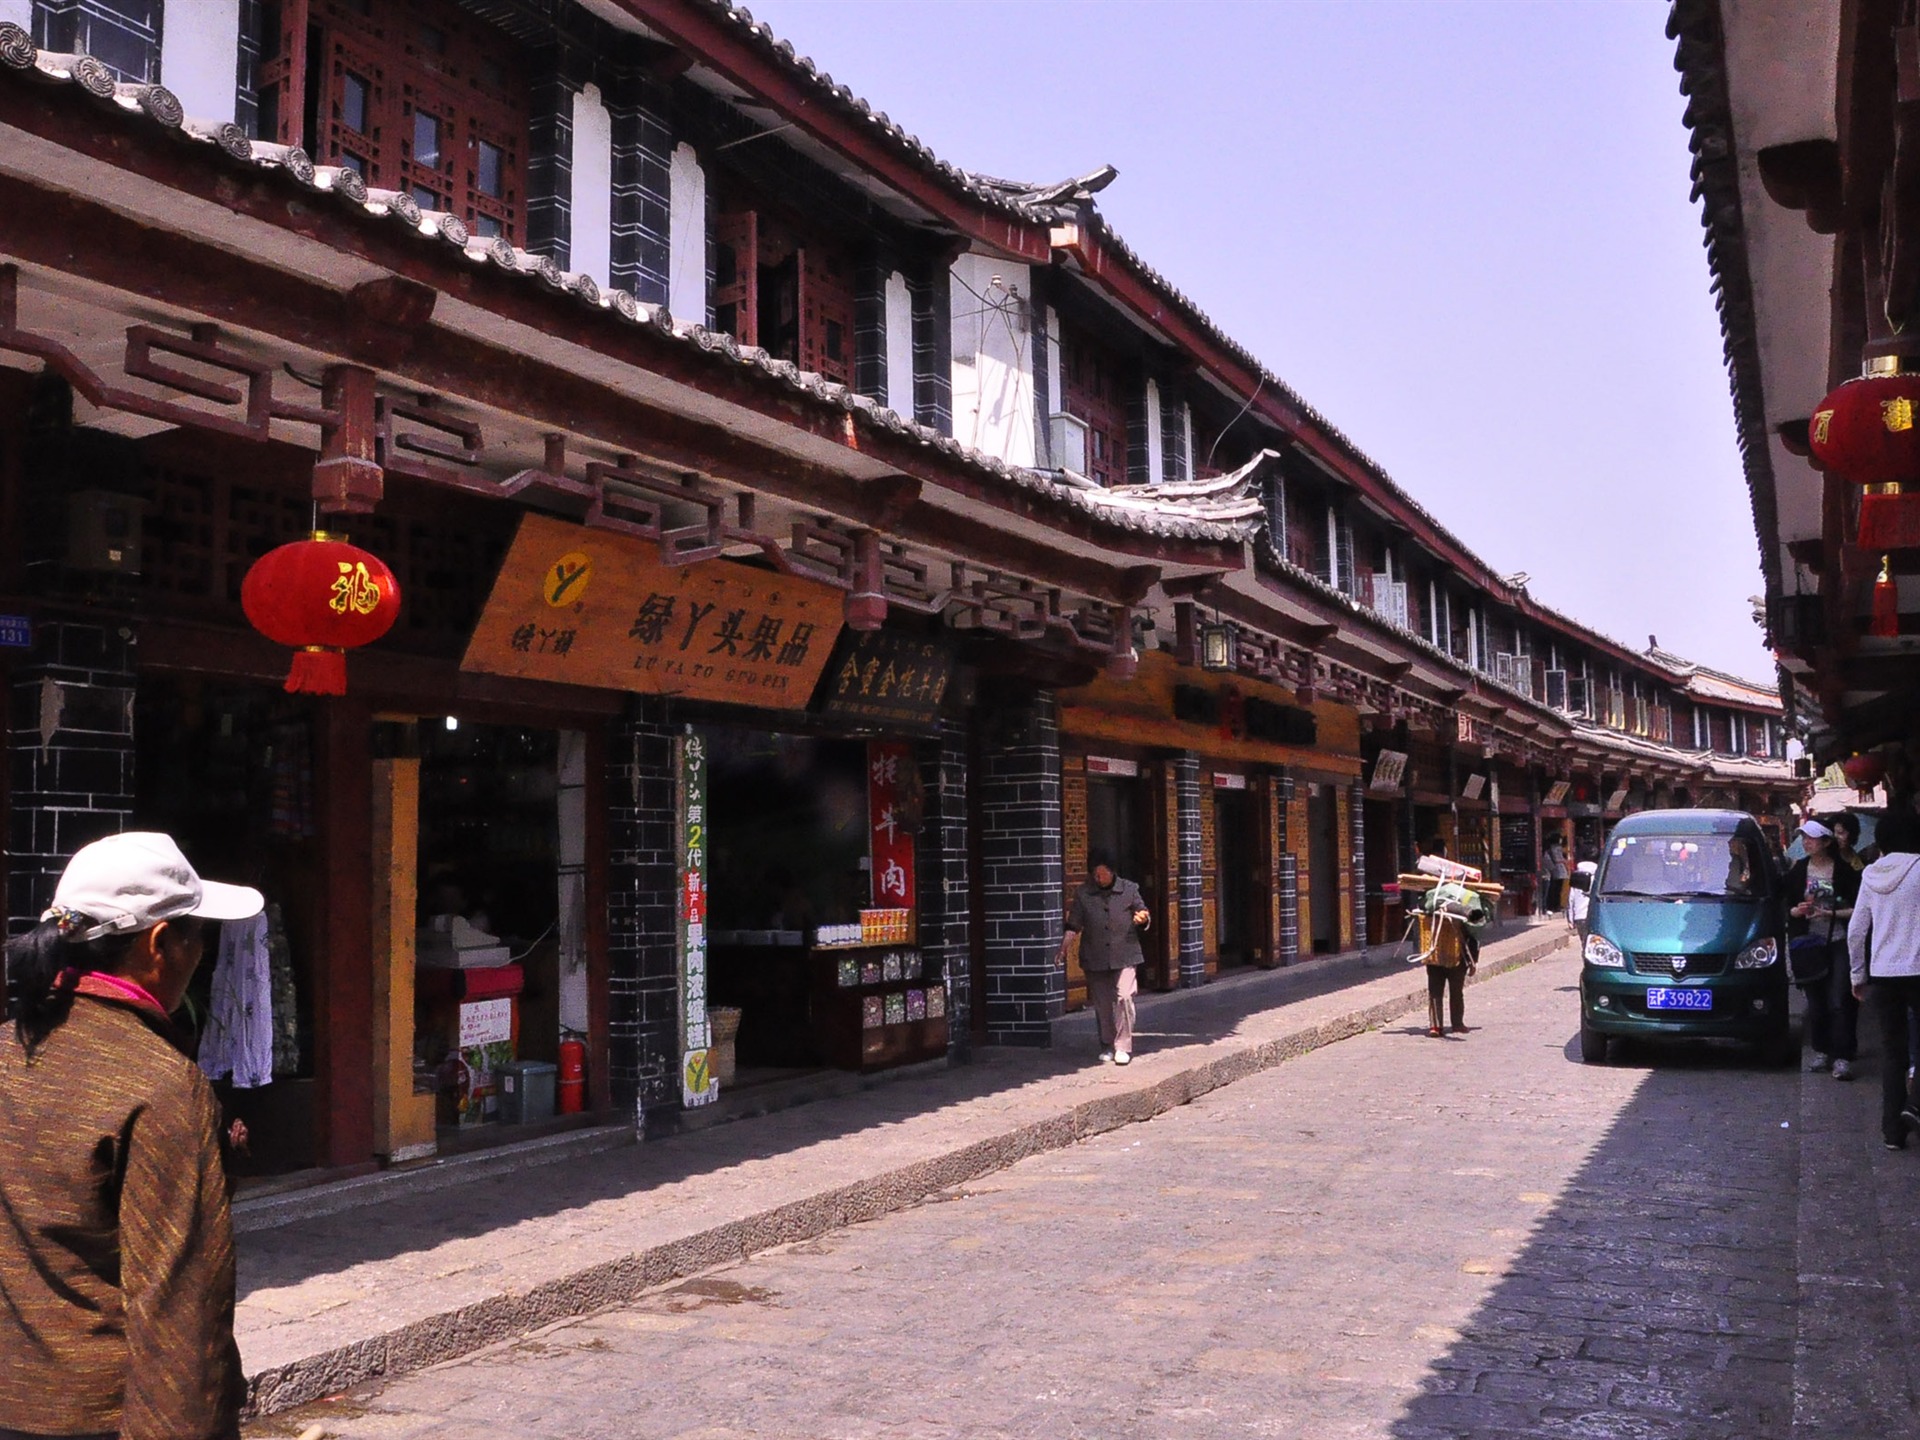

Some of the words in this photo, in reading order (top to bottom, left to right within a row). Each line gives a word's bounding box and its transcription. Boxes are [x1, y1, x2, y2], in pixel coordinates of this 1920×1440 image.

[329, 561, 381, 615] 福
[0, 628, 23, 643] 131
[628, 591, 815, 666] 绿丫头果品
[691, 664, 714, 678] TO
